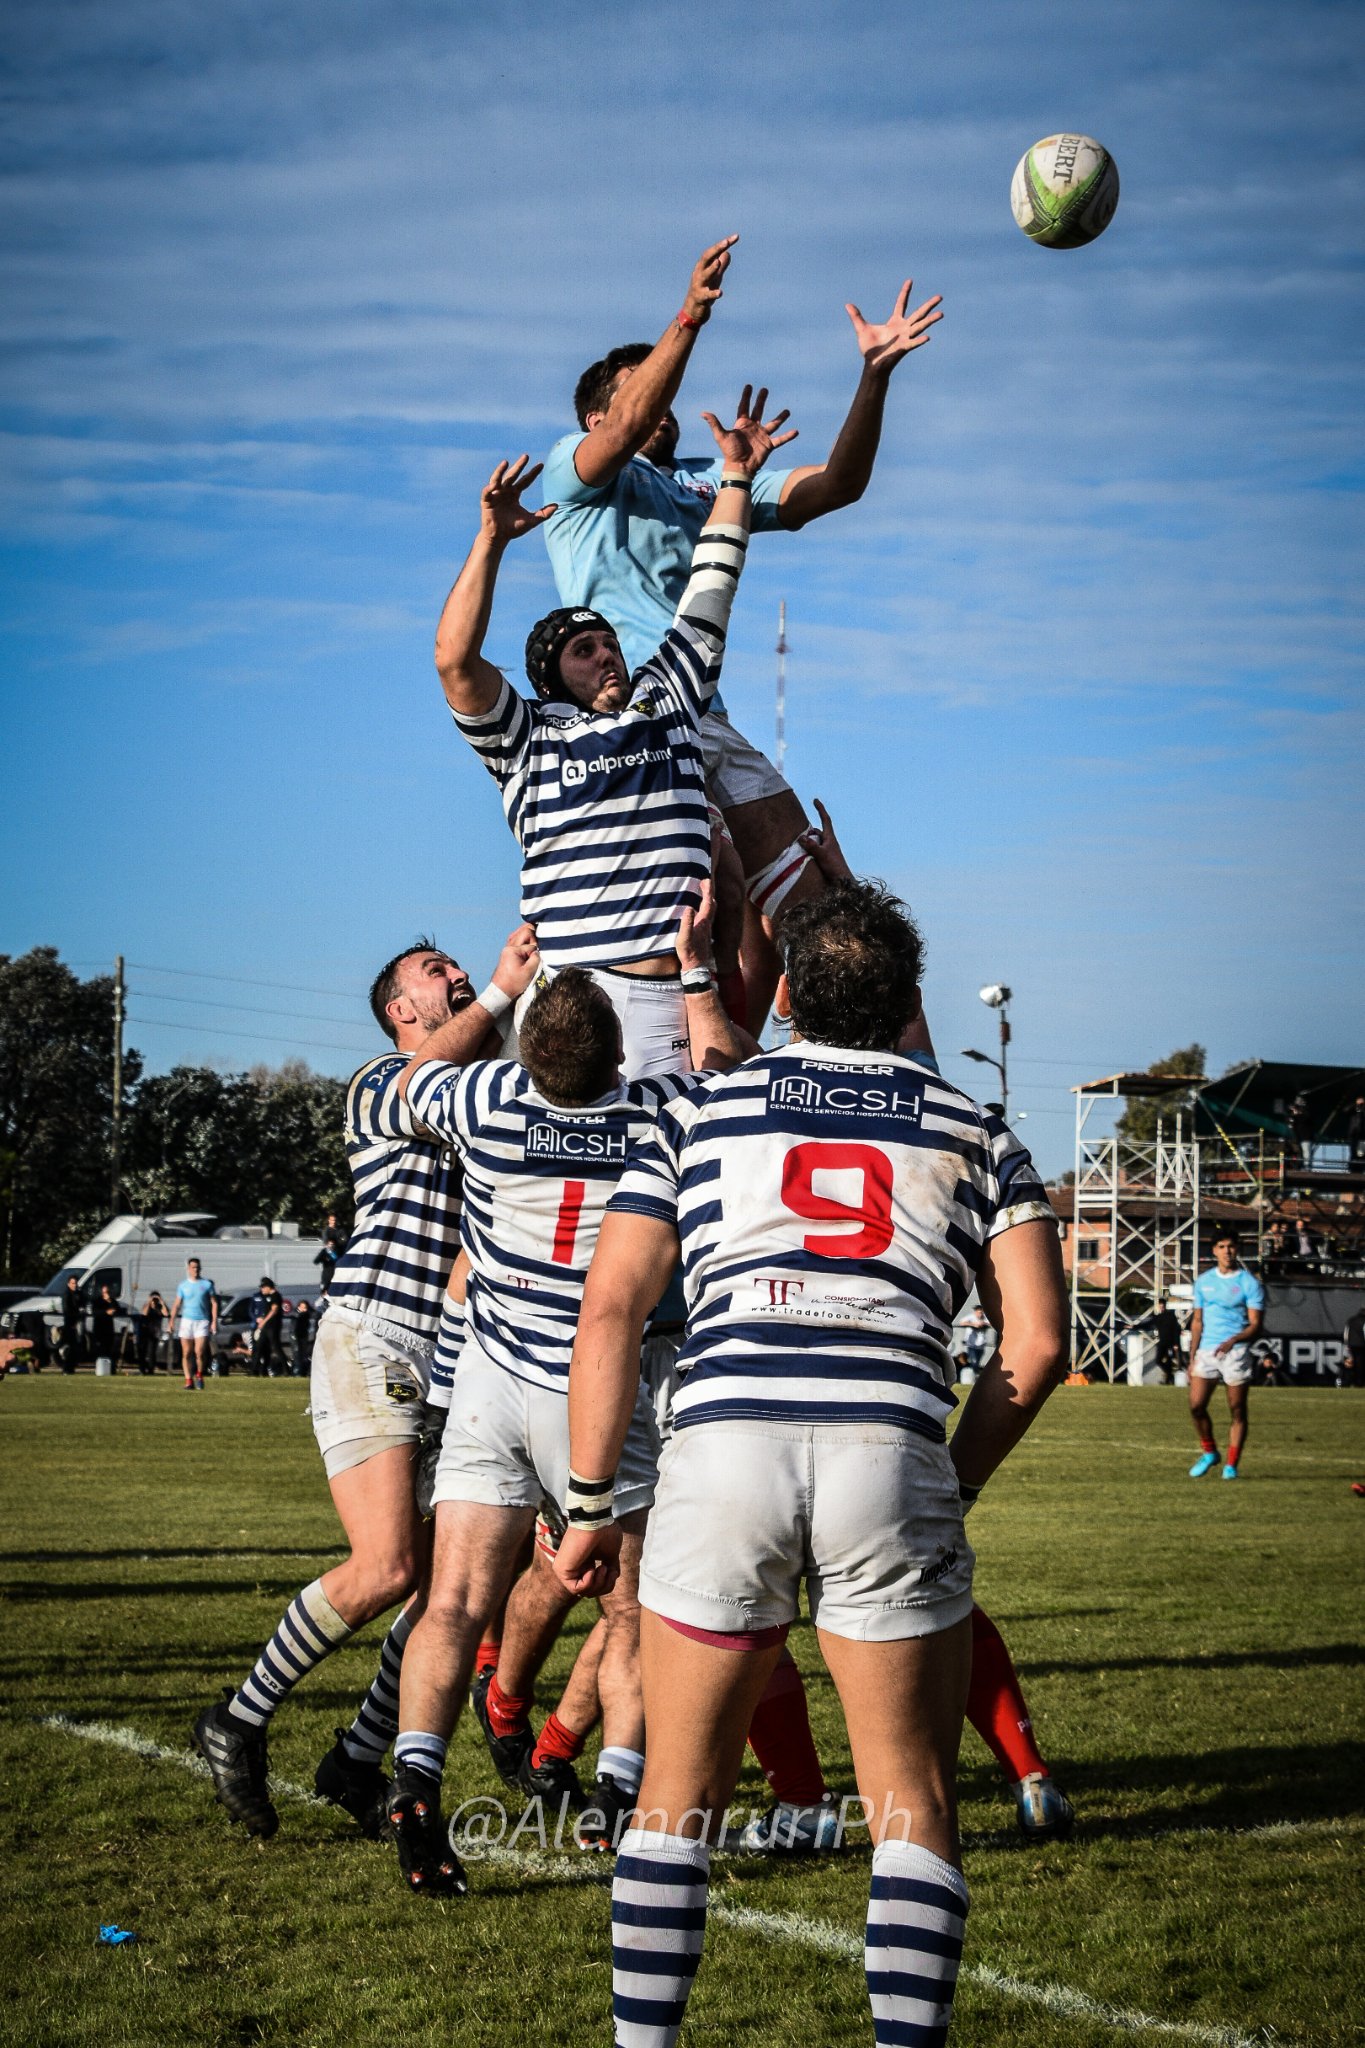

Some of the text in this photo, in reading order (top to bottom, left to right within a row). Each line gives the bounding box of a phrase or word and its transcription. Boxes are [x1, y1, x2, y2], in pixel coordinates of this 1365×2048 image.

[801, 1060, 894, 1076] PROCER
[769, 1103, 801, 1112] CENTRO
[814, 1108, 855, 1116] SERVICIOS
[856, 1111, 917, 1122] HOSPITALARIOS
[551, 1180, 585, 1265] 1
[781, 1141, 895, 1259] 9
